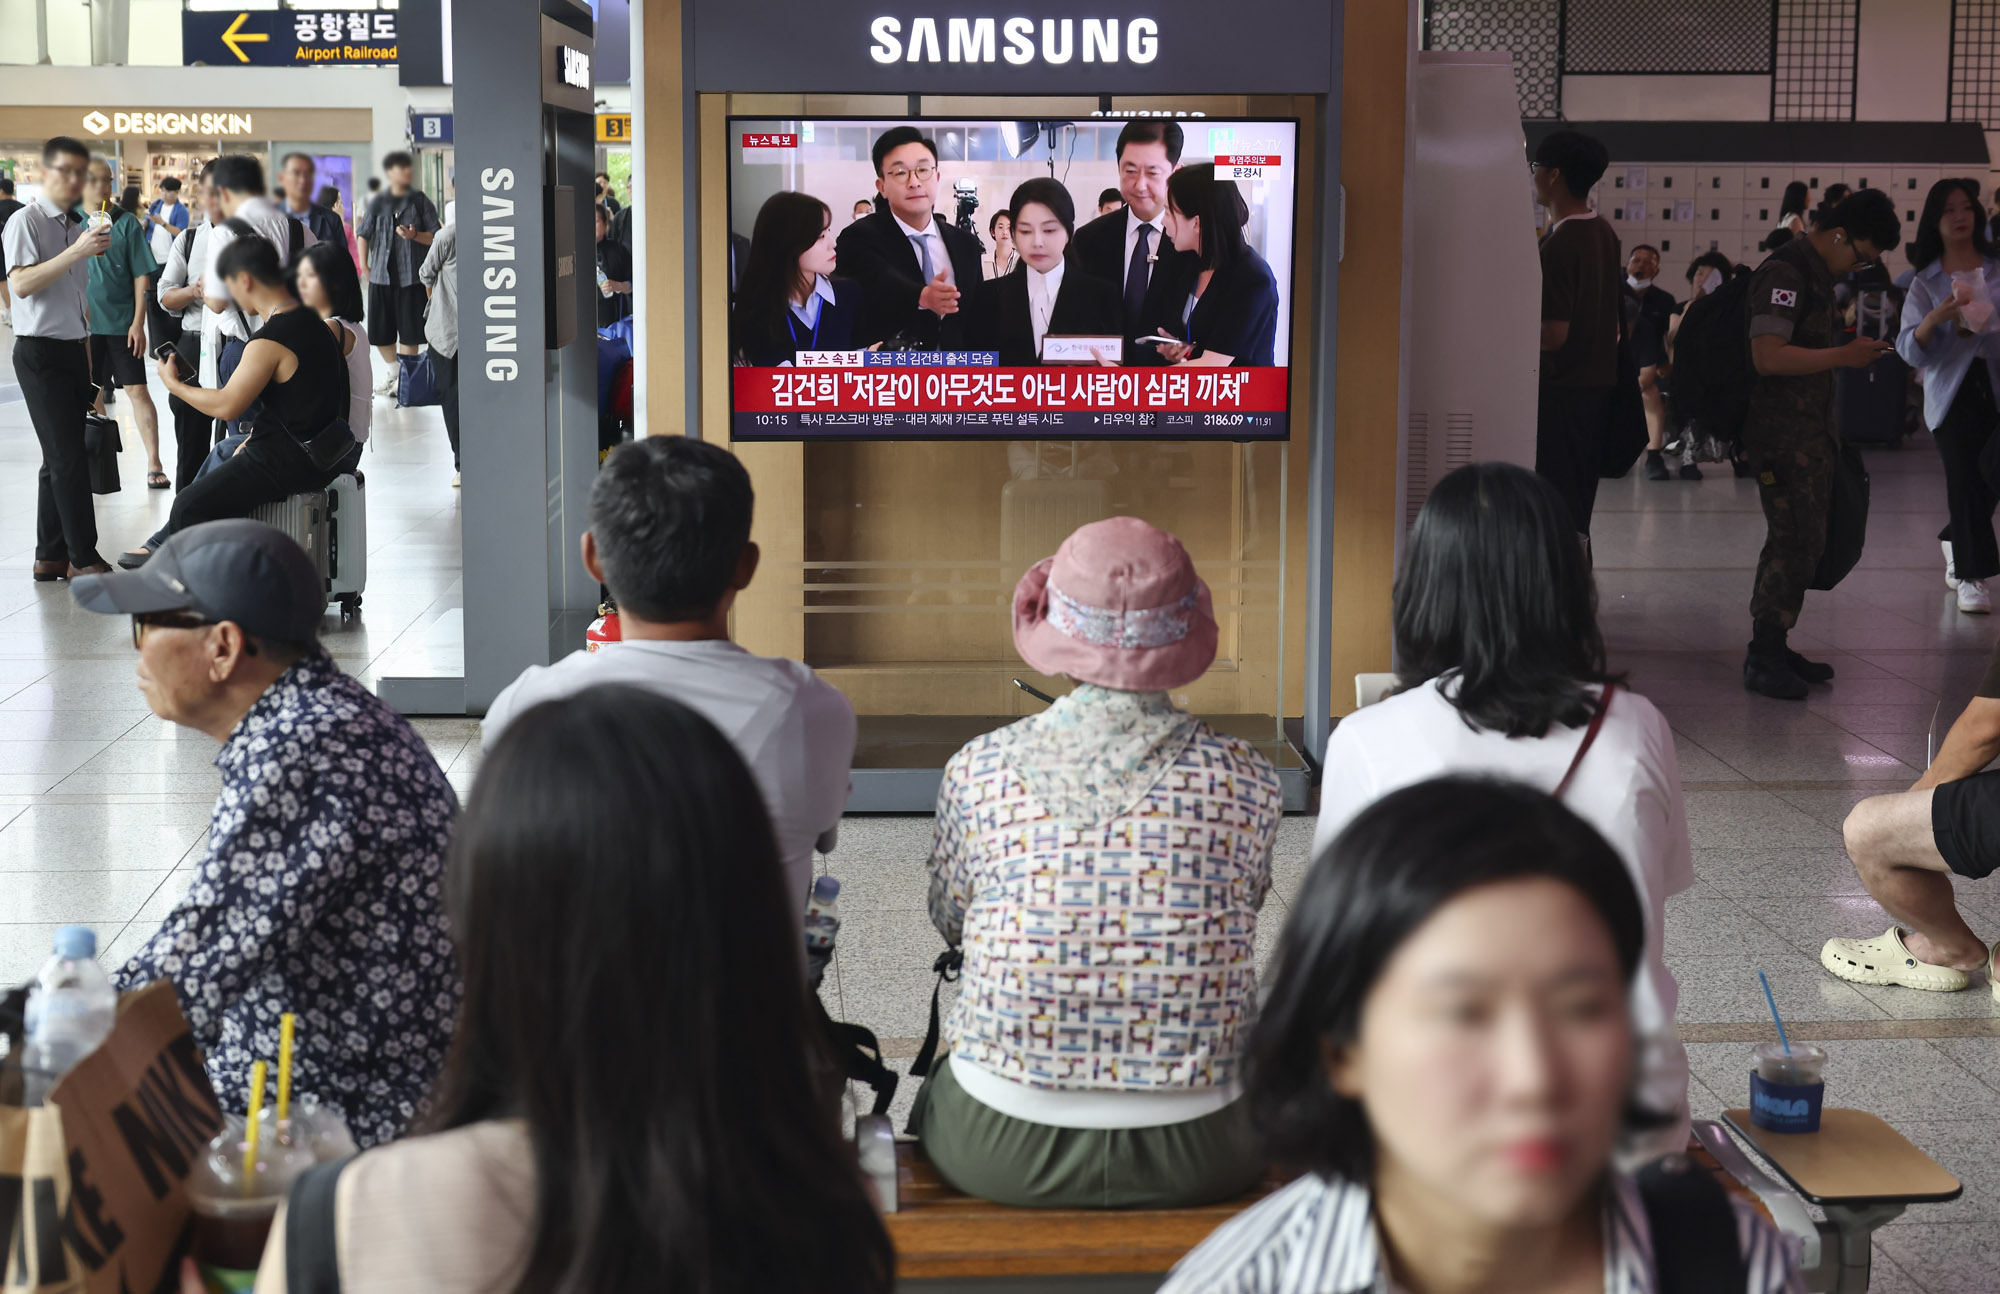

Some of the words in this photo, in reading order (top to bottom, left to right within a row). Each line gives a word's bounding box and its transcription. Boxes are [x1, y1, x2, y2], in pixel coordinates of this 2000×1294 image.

[294, 13, 398, 42] 공항철도
[870, 16, 1158, 65] SAMSUNG
[295, 46, 341, 61] Airport
[344, 45, 398, 60] Railroad
[114, 112, 198, 134] DESIGN
[200, 112, 252, 134] SKIN
[427, 120, 436, 135] 3
[608, 120, 619, 136] 3
[749, 136, 791, 146] 뉴스특보
[1229, 156, 1267, 164] 폭염주의보
[1233, 167, 1261, 178] 문경시
[481, 168, 518, 381] SAMSUNG
[870, 352, 892, 366] 조금
[895, 352, 906, 366] 전
[909, 352, 943, 366] 김건희
[945, 352, 968, 366] 출석
[971, 352, 994, 366] 모습
[771, 373, 839, 407] 김건희
[843, 372, 919, 407] "저같이
[926, 373, 1017, 407] 아무것도
[1021, 373, 1066, 407] 아닌
[1071, 373, 1139, 407] 사람이
[1145, 373, 1190, 407] 심려
[1195, 372, 1250, 407] 끼쳐"
[755, 414, 788, 425] 10:15
[799, 413, 822, 426] 특사
[825, 413, 869, 426] 모스크바
[930, 413, 953, 426] 제재
[955, 413, 989, 426] 카드로
[991, 413, 1013, 426] 푸틴
[1016, 413, 1039, 426] 설득
[1041, 413, 1065, 426] 시도
[1166, 414, 1194, 426] 코스피
[1203, 414, 1244, 426] 3186.09
